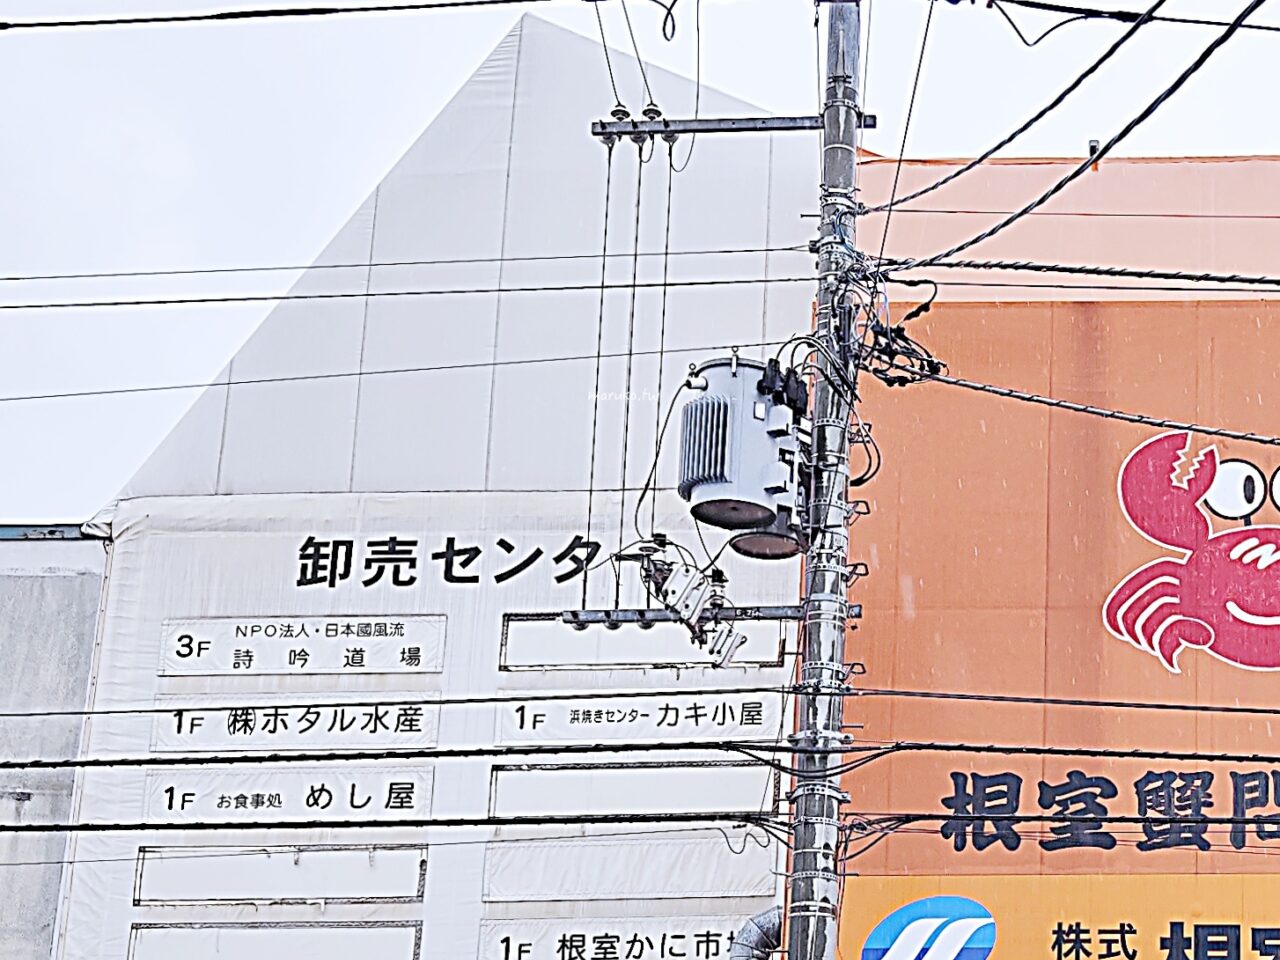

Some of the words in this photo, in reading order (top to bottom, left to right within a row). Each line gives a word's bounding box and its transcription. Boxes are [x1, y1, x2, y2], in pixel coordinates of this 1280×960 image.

[175, 634, 211, 658] 3F
[172, 709, 205, 735] 1F
[515, 705, 546, 729] 1F
[569, 708, 650, 724] 浜焼きセンター
[656, 701, 763, 727] カキ小屋
[164, 786, 196, 811] 1F
[216, 793, 283, 809] お食事処
[305, 782, 415, 810] めし屋
